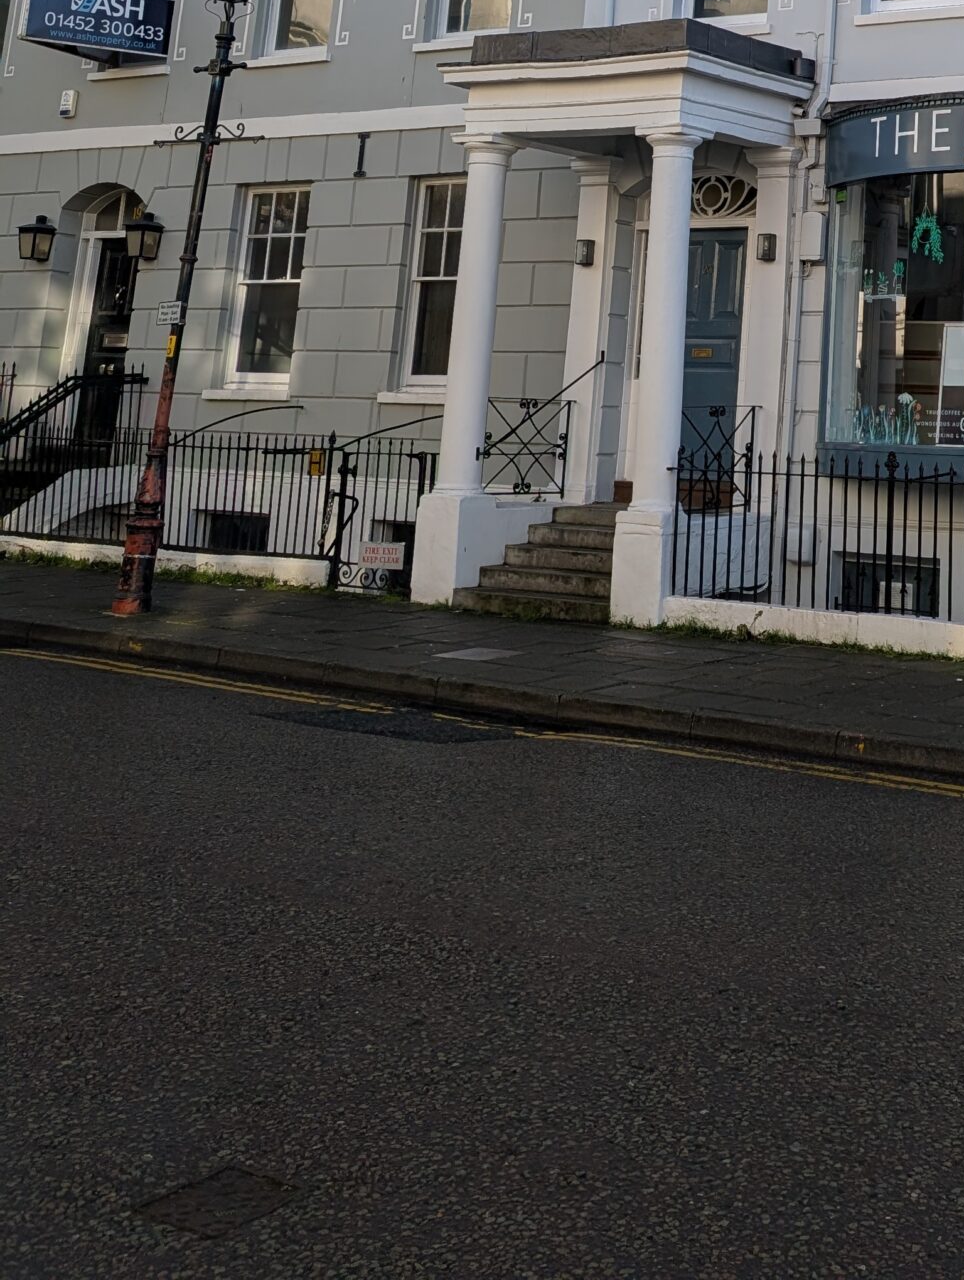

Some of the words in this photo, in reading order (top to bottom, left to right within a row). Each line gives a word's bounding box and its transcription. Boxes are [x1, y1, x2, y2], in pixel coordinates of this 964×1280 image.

[44, 11, 95, 32] 01452
[100, 20, 164, 41] 300433
[49, 29, 157, 50] www.ashproperty.co.uk
[133, 207, 142, 220] 19
[365, 546, 380, 555] FIRE
[382, 547, 399, 555] EXIT
[362, 556, 378, 564] KEEP
[379, 556, 400, 564] CLEAR
